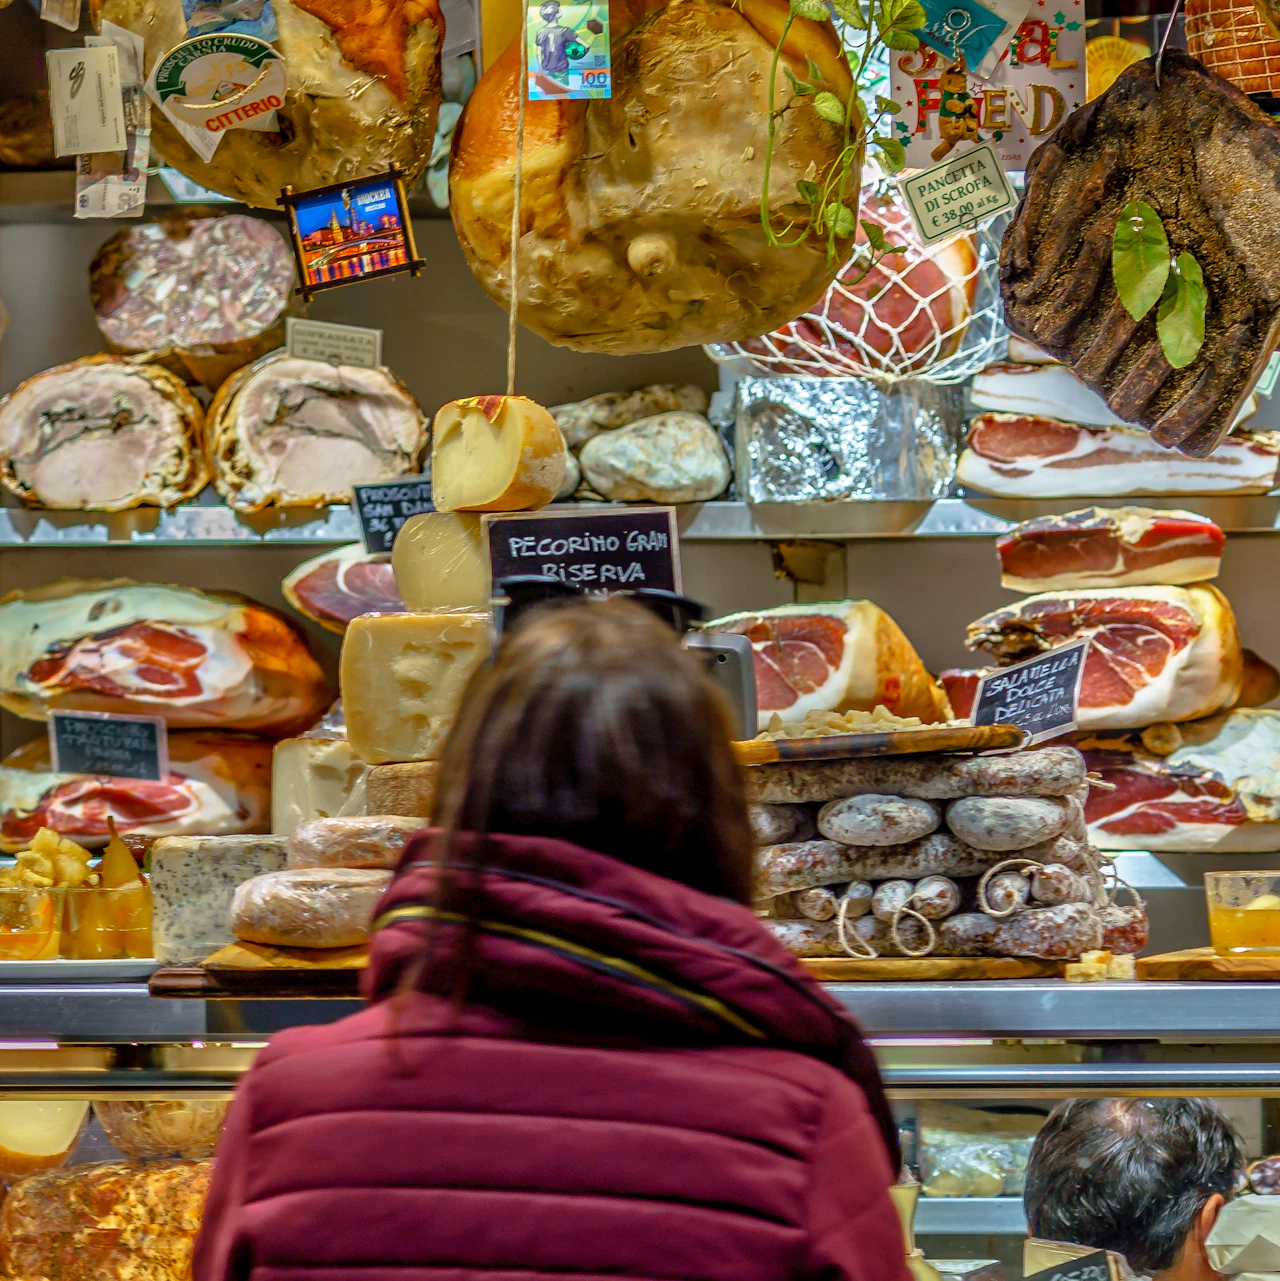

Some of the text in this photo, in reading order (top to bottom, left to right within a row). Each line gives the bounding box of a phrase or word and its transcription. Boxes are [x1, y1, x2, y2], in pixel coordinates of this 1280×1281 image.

[178, 45, 227, 67] CARNIA
[547, 33, 555, 53] 1
[157, 36, 259, 83] PROSCIUTTO CRUDO
[579, 71, 607, 85] 100
[205, 93, 283, 133] CITTERIO
[916, 159, 987, 199] PANCETTA
[356, 187, 392, 206] МОСКВА
[923, 175, 993, 213] DI SCROFA
[932, 215, 941, 228] €
[977, 197, 985, 209] al
[986, 194, 1000, 205] Kg
[359, 482, 432, 505] PROSCIUT
[363, 501, 436, 517] SAN DAN
[507, 530, 669, 558] PECORINO GRAN
[541, 561, 647, 583] RISERVA
[984, 651, 1080, 697] SALAMELLA
[1005, 676, 1057, 704] DOLCE
[993, 686, 1066, 723] DELICATA
